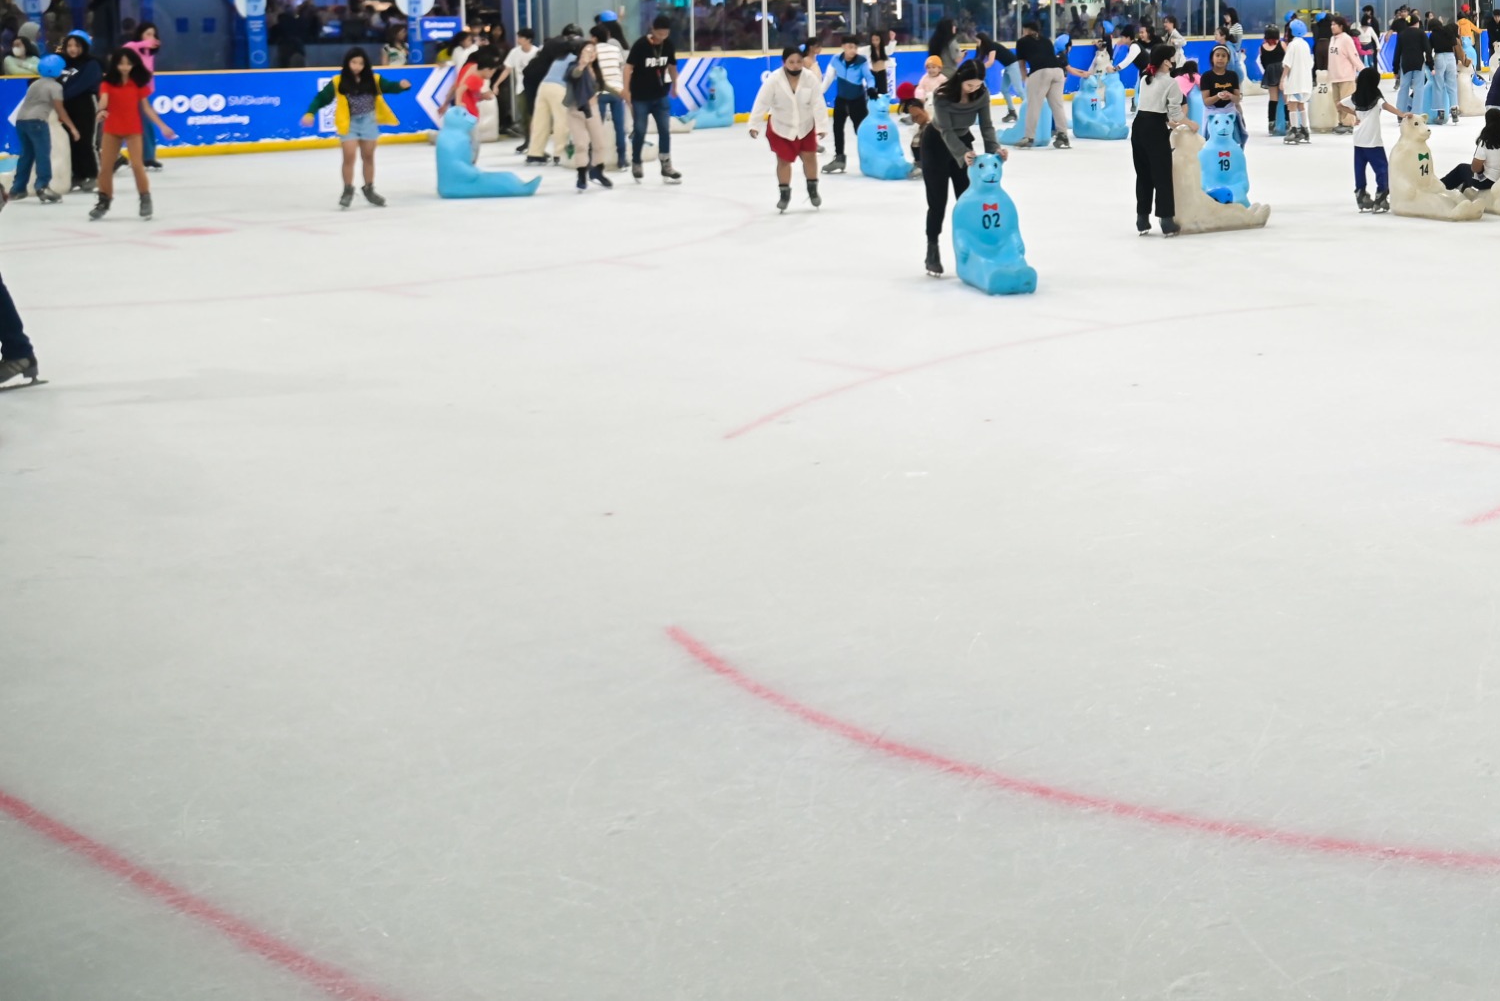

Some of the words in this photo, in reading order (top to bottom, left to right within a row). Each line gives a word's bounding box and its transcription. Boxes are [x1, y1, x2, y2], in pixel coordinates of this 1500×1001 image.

[1318, 86, 1328, 94] 20
[876, 131, 889, 142] 39
[1218, 158, 1231, 172] 19
[1419, 163, 1429, 177] 14
[982, 212, 1001, 230] 02
